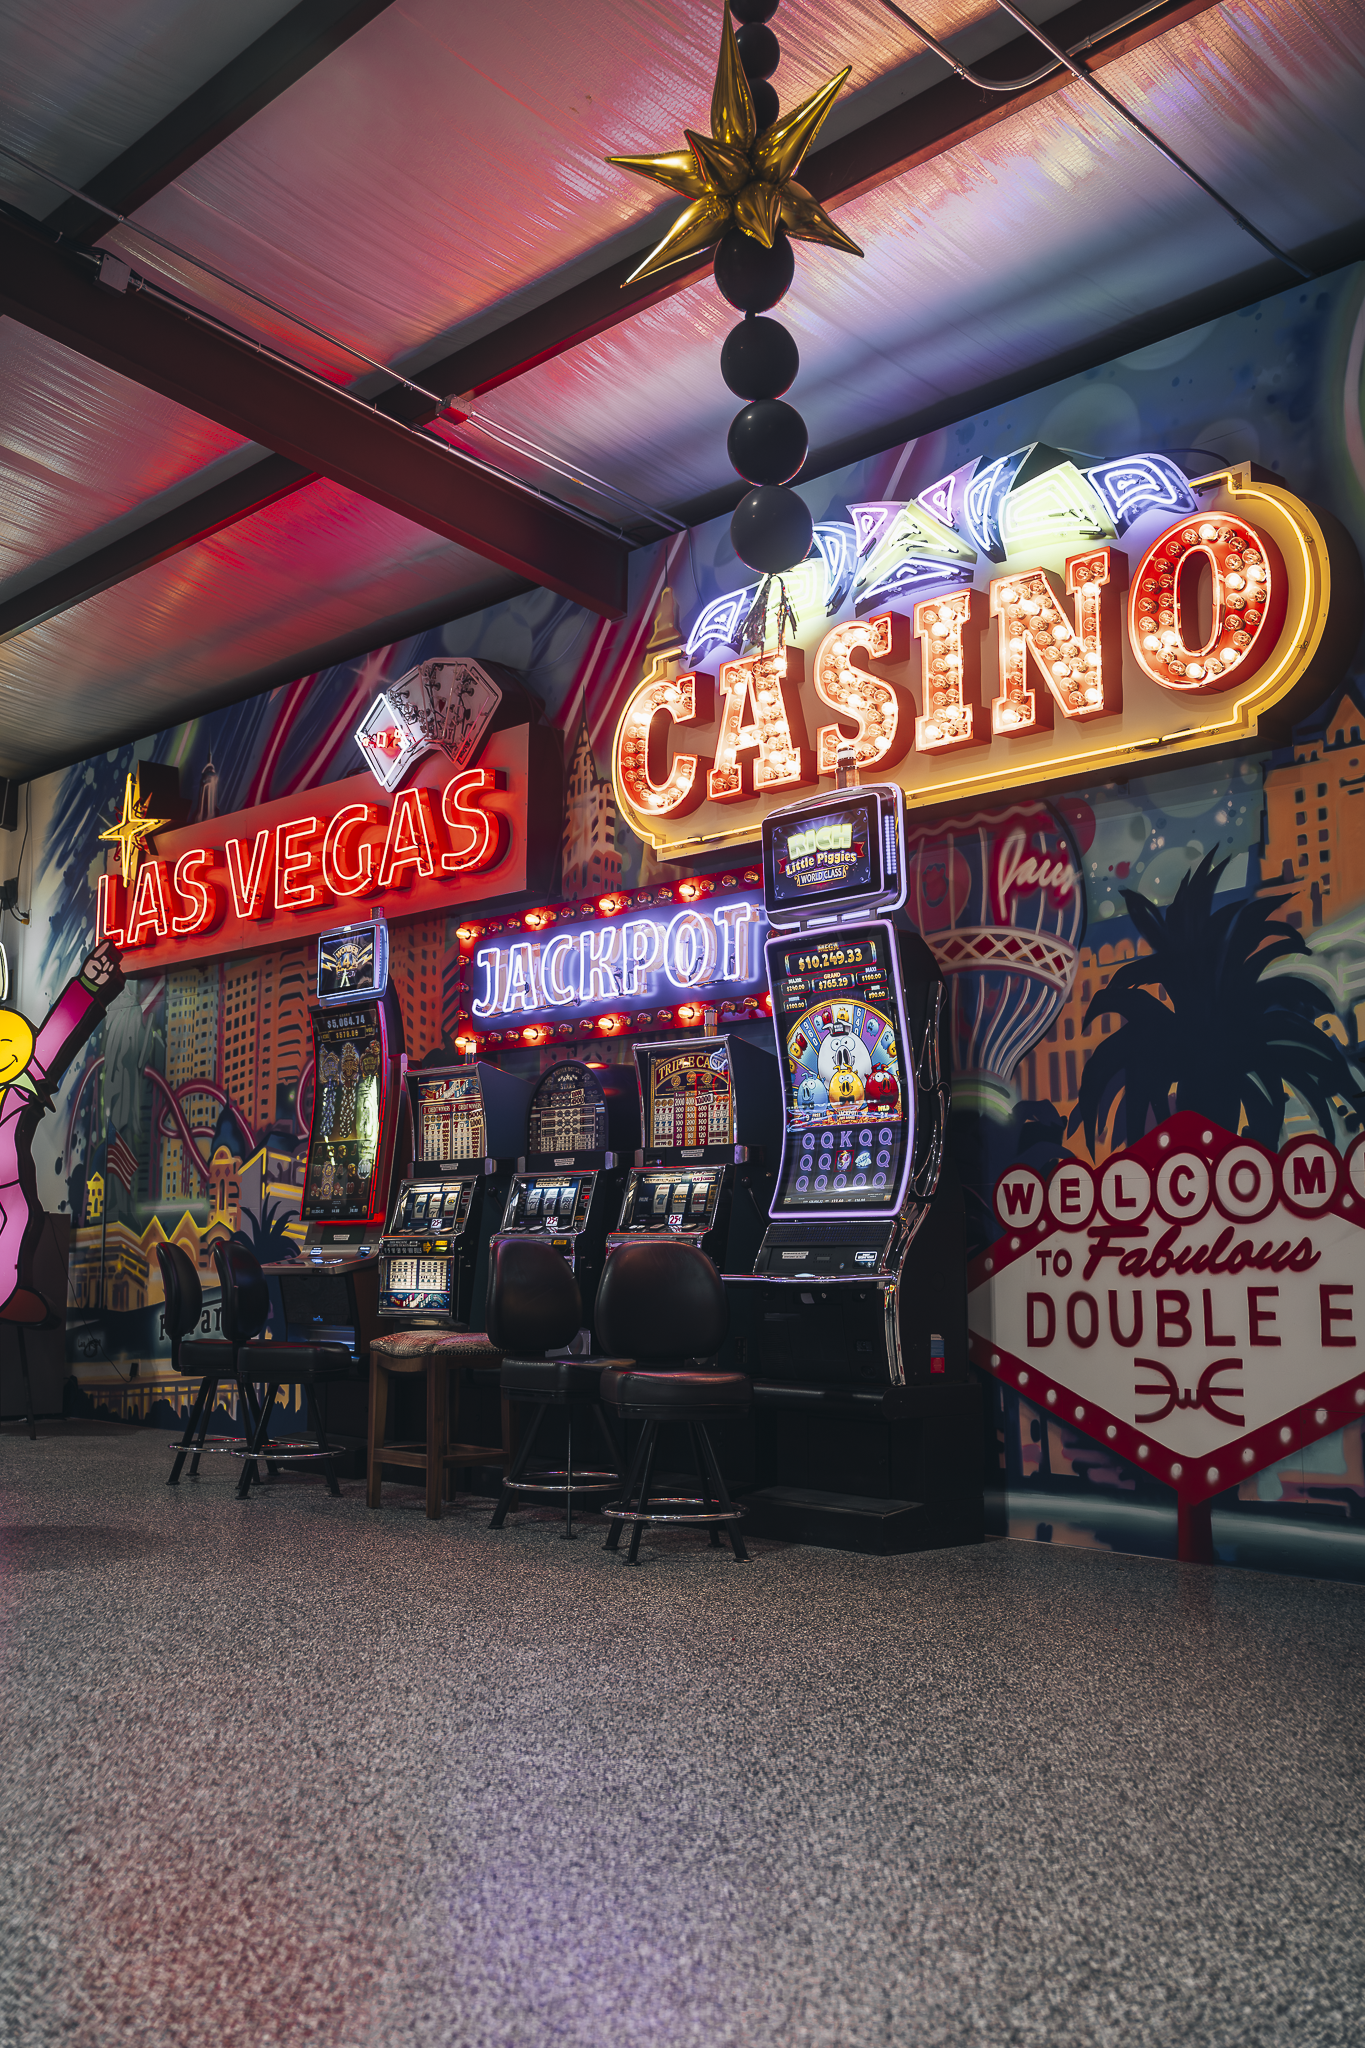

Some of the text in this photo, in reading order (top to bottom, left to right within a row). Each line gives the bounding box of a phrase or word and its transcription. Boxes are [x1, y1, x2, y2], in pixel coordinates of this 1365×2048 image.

[617, 512, 1272, 816] CASINO
[787, 823, 853, 861] RICH
[95, 768, 498, 948] LAS VEGAS
[785, 850, 858, 876] Little Piggies
[800, 867, 842, 884] WORLD CLASS
[335, 944, 359, 959] WONDER
[471, 902, 752, 1017] JACKPOT
[798, 948, 863, 972] $10,249.33
[817, 942, 840, 953] MEGA
[342, 953, 350, 968] 4
[818, 976, 849, 991] $765.29
[823, 972, 841, 980] GRAND
[658, 1056, 695, 1081] TRIPLE
[1002, 1152, 1365, 1215] WELCOM
[1036, 1226, 1322, 1281] TO Fabulous
[1025, 1284, 1357, 1349] DOUBLE E
